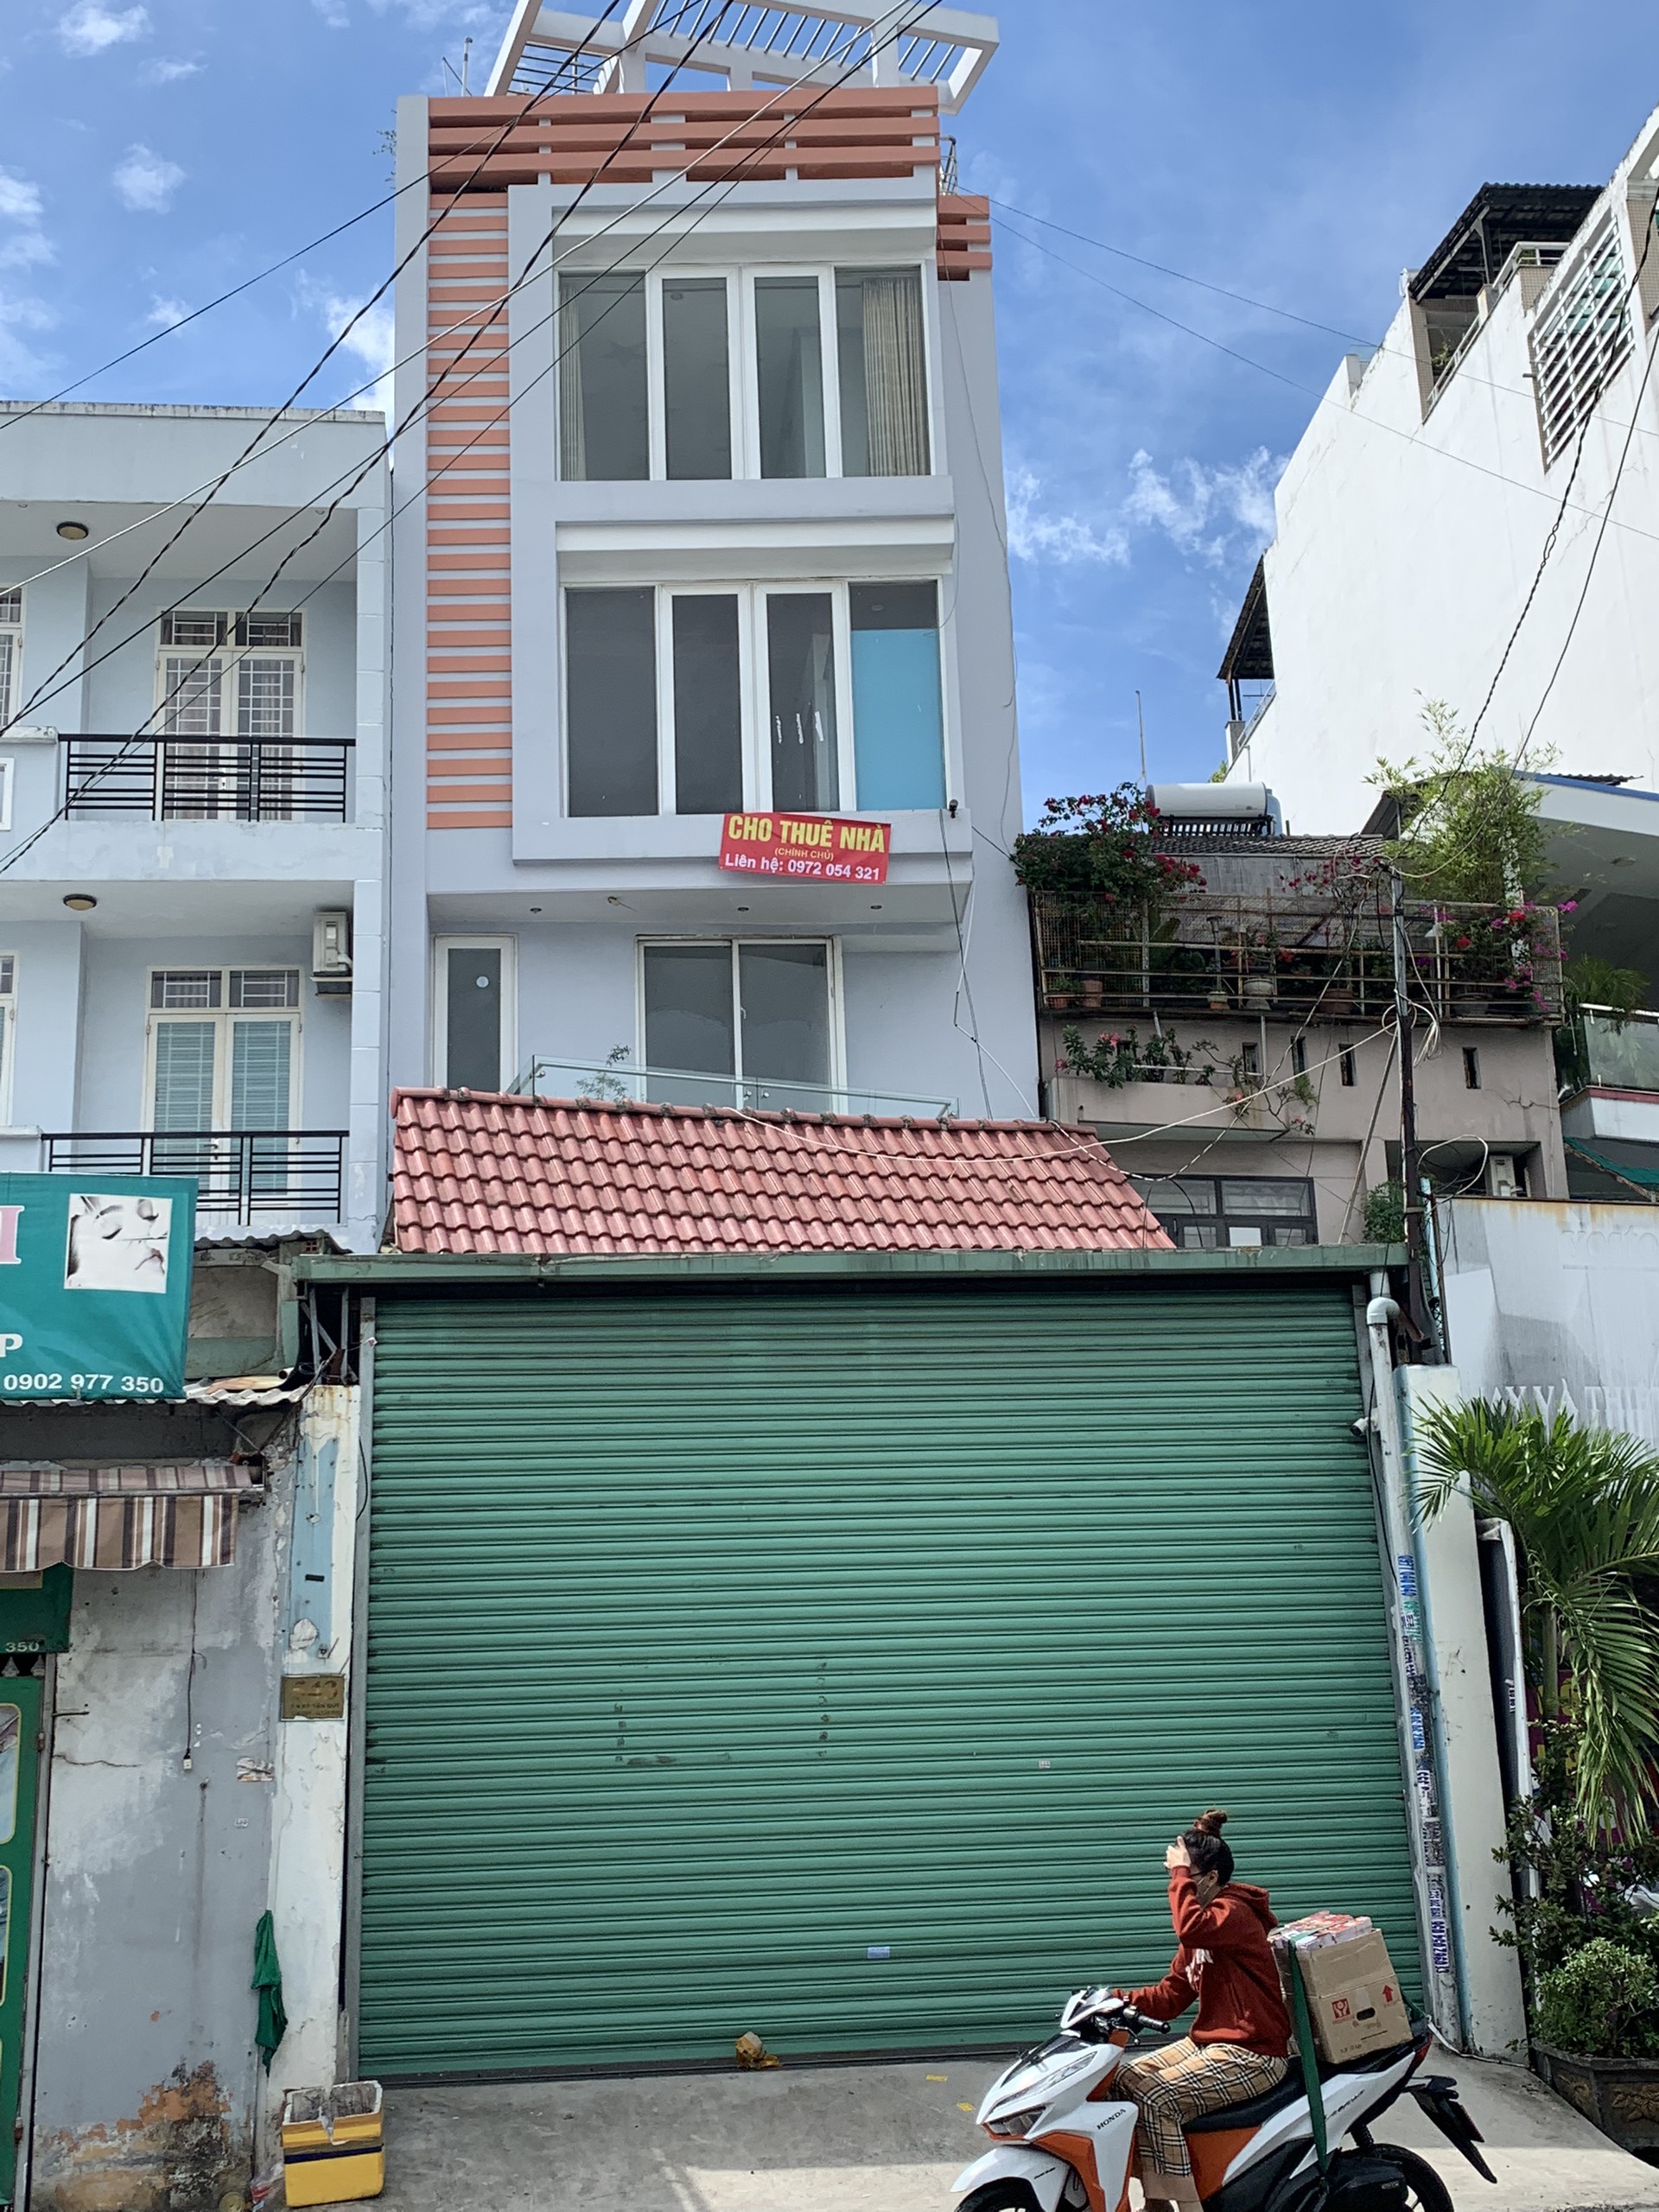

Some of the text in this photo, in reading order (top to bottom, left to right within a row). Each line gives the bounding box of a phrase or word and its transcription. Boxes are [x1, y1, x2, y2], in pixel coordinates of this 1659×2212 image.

[728, 816, 885, 853] CHO THUÊ NHÀ
[774, 847, 808, 858] (CHÍNH
[725, 853, 880, 880] Liên hệ: 0972 054 321
[3, 1373, 164, 1394] 0902 977 350
[5, 1641, 40, 1652] 350
[1096, 2108, 1127, 2130] HONDA
